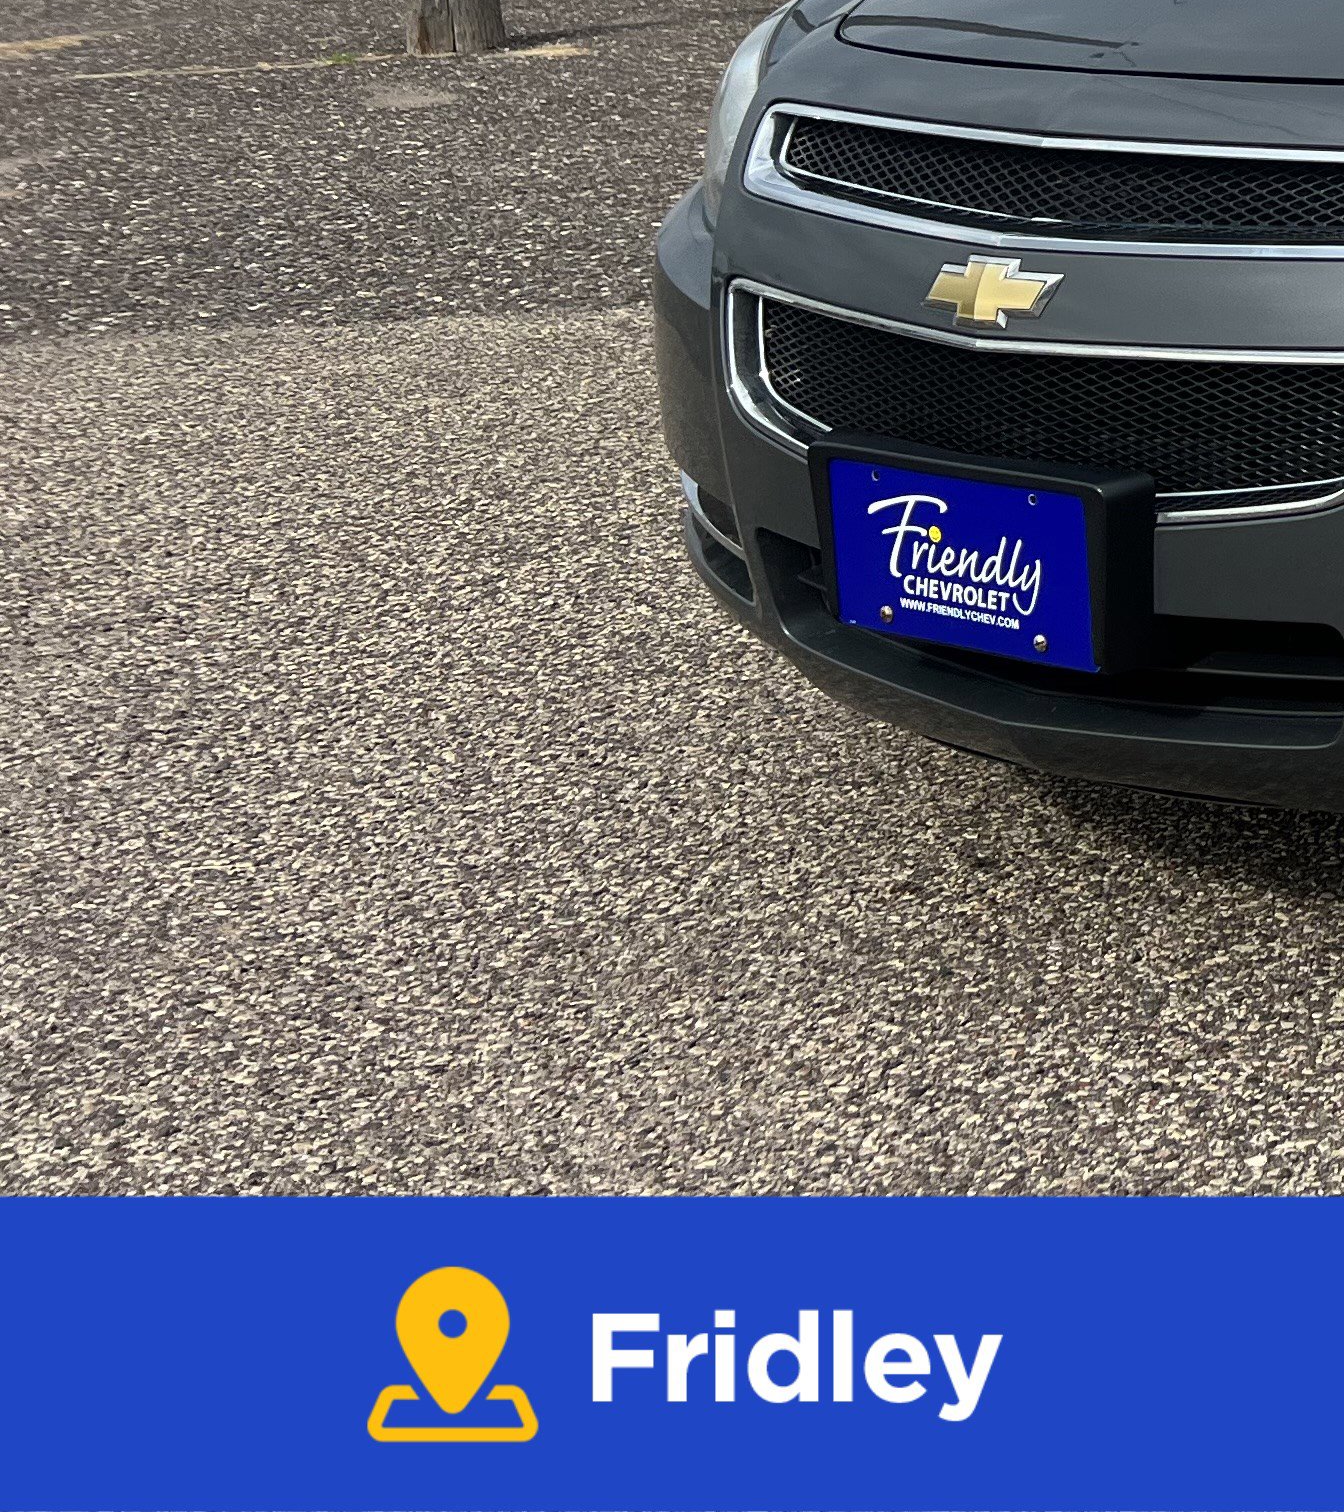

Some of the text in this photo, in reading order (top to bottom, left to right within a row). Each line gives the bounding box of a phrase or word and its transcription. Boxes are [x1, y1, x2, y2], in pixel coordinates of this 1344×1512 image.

[867, 494, 1041, 616] Friendly
[903, 573, 1010, 612] CHEVROLET
[900, 596, 1020, 630] WWW.FRIENDLYCHEV.COM
